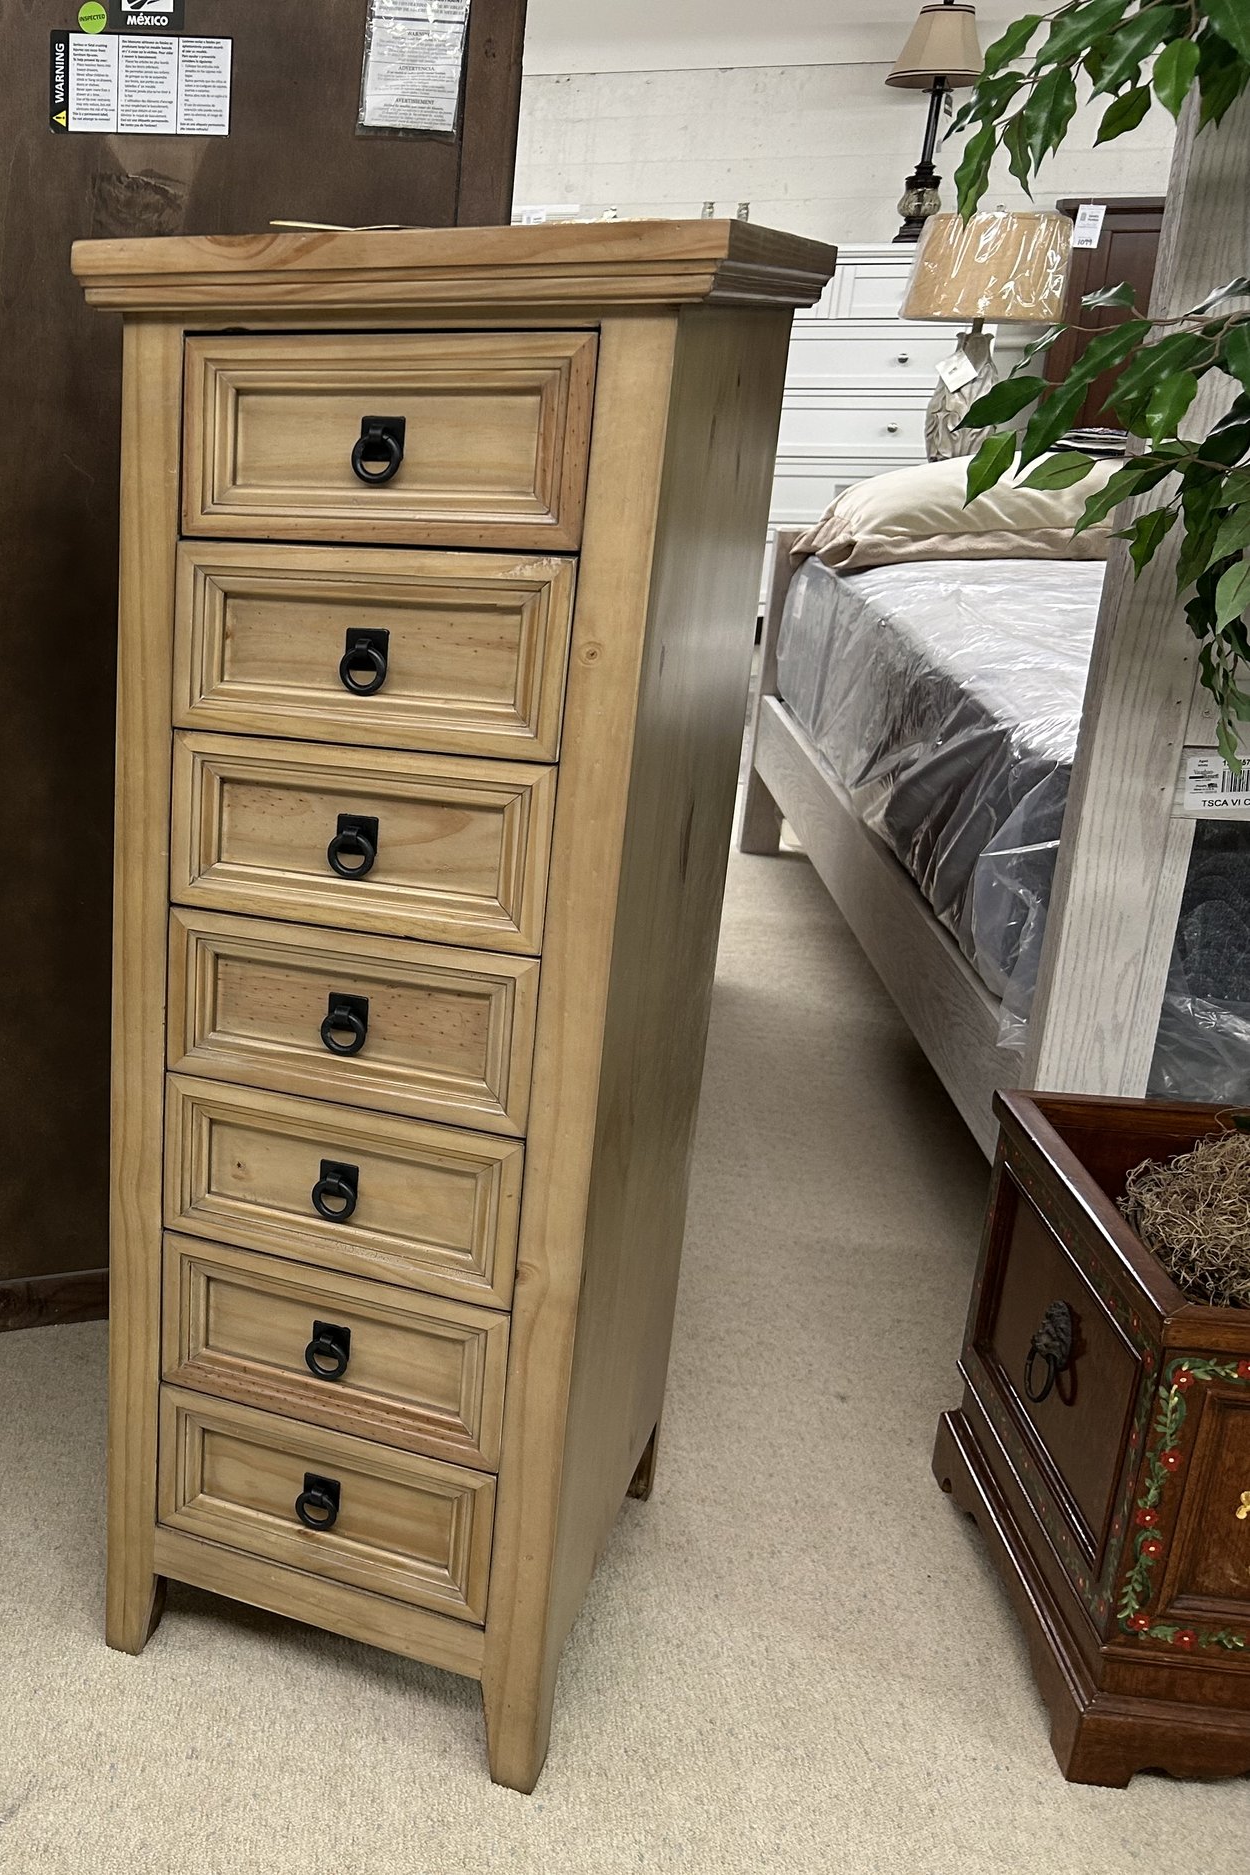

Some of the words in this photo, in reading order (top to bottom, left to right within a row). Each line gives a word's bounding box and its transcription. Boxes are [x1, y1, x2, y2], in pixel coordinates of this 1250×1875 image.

[79, 14, 106, 22] INSPECTED
[55, 42, 65, 104] WARNING
[1201, 799, 1229, 807] TSCA
